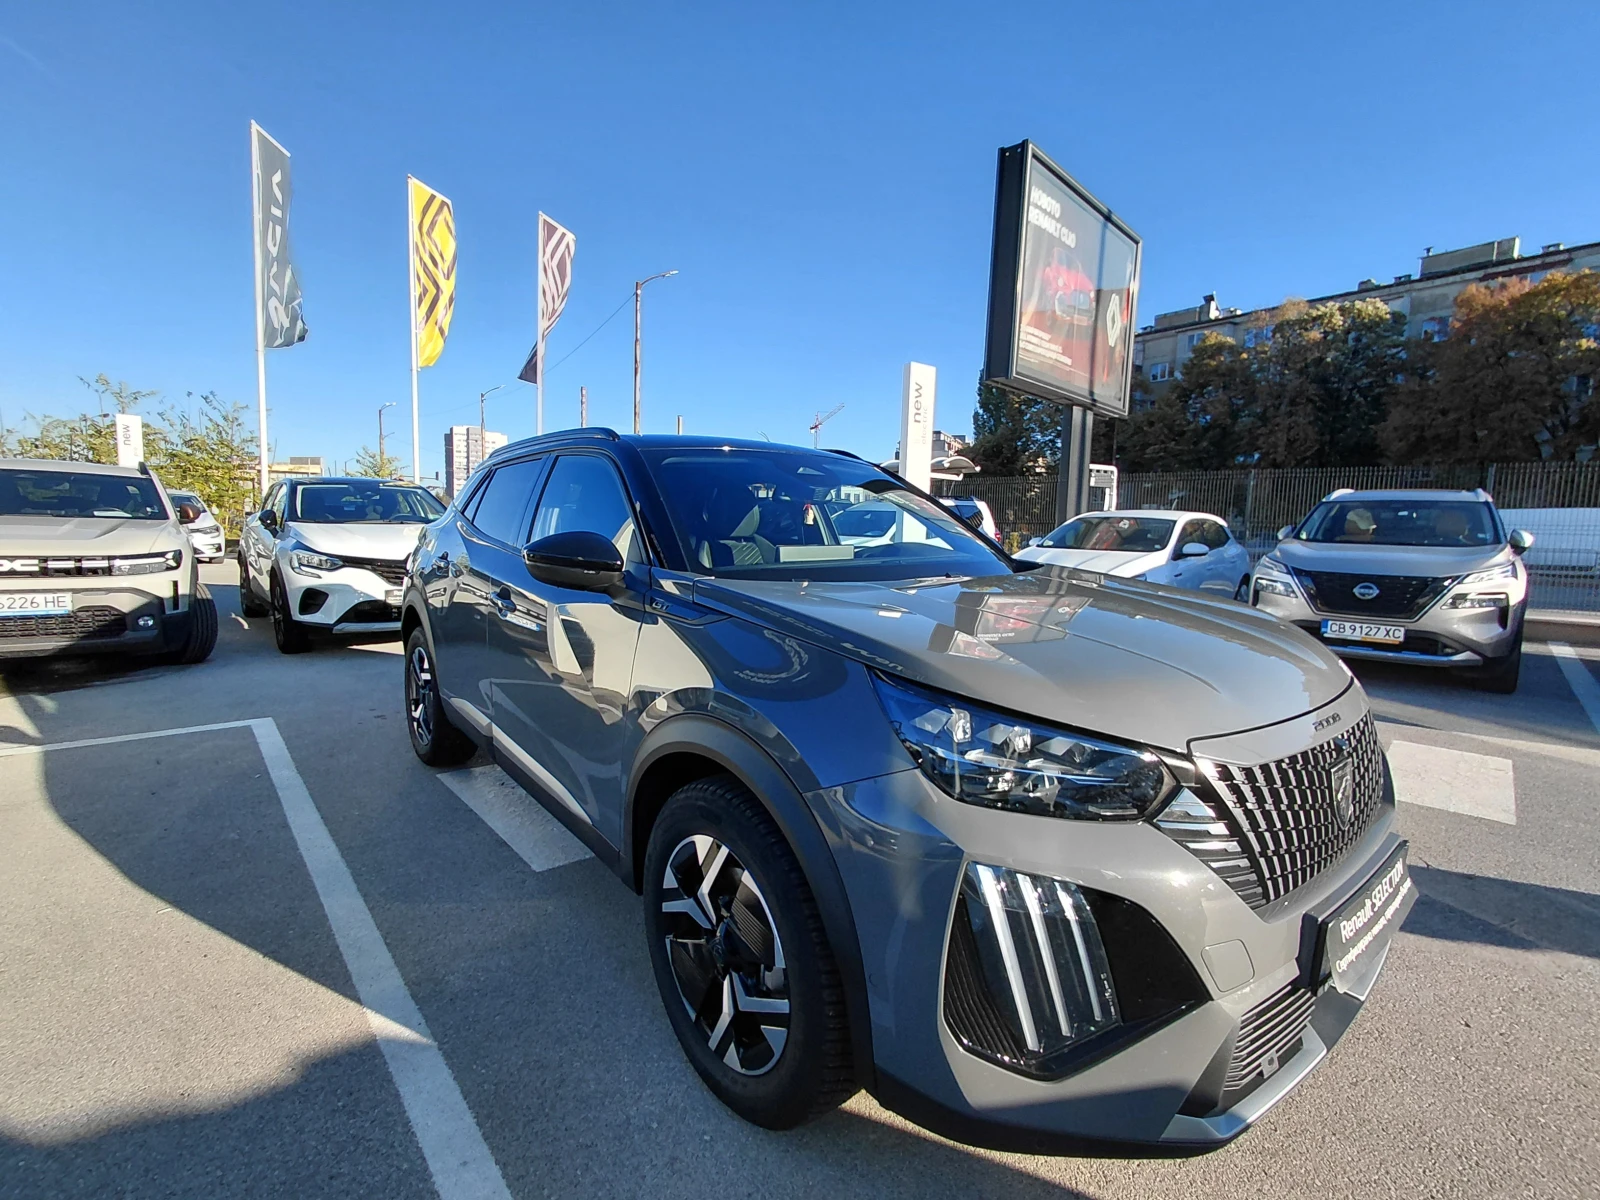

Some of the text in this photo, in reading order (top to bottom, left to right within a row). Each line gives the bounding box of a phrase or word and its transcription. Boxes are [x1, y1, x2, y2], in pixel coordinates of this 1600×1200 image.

[1028, 205, 1076, 249] RENAULT CLIO
[914, 381, 923, 424] new
[122, 423, 131, 446] new
[44, 595, 68, 608] HE
[1329, 622, 1402, 639] CB 9127 XC
[1312, 712, 1342, 732] 2008
[1340, 898, 1374, 943] Renault
[1371, 858, 1404, 912] SELECTION
